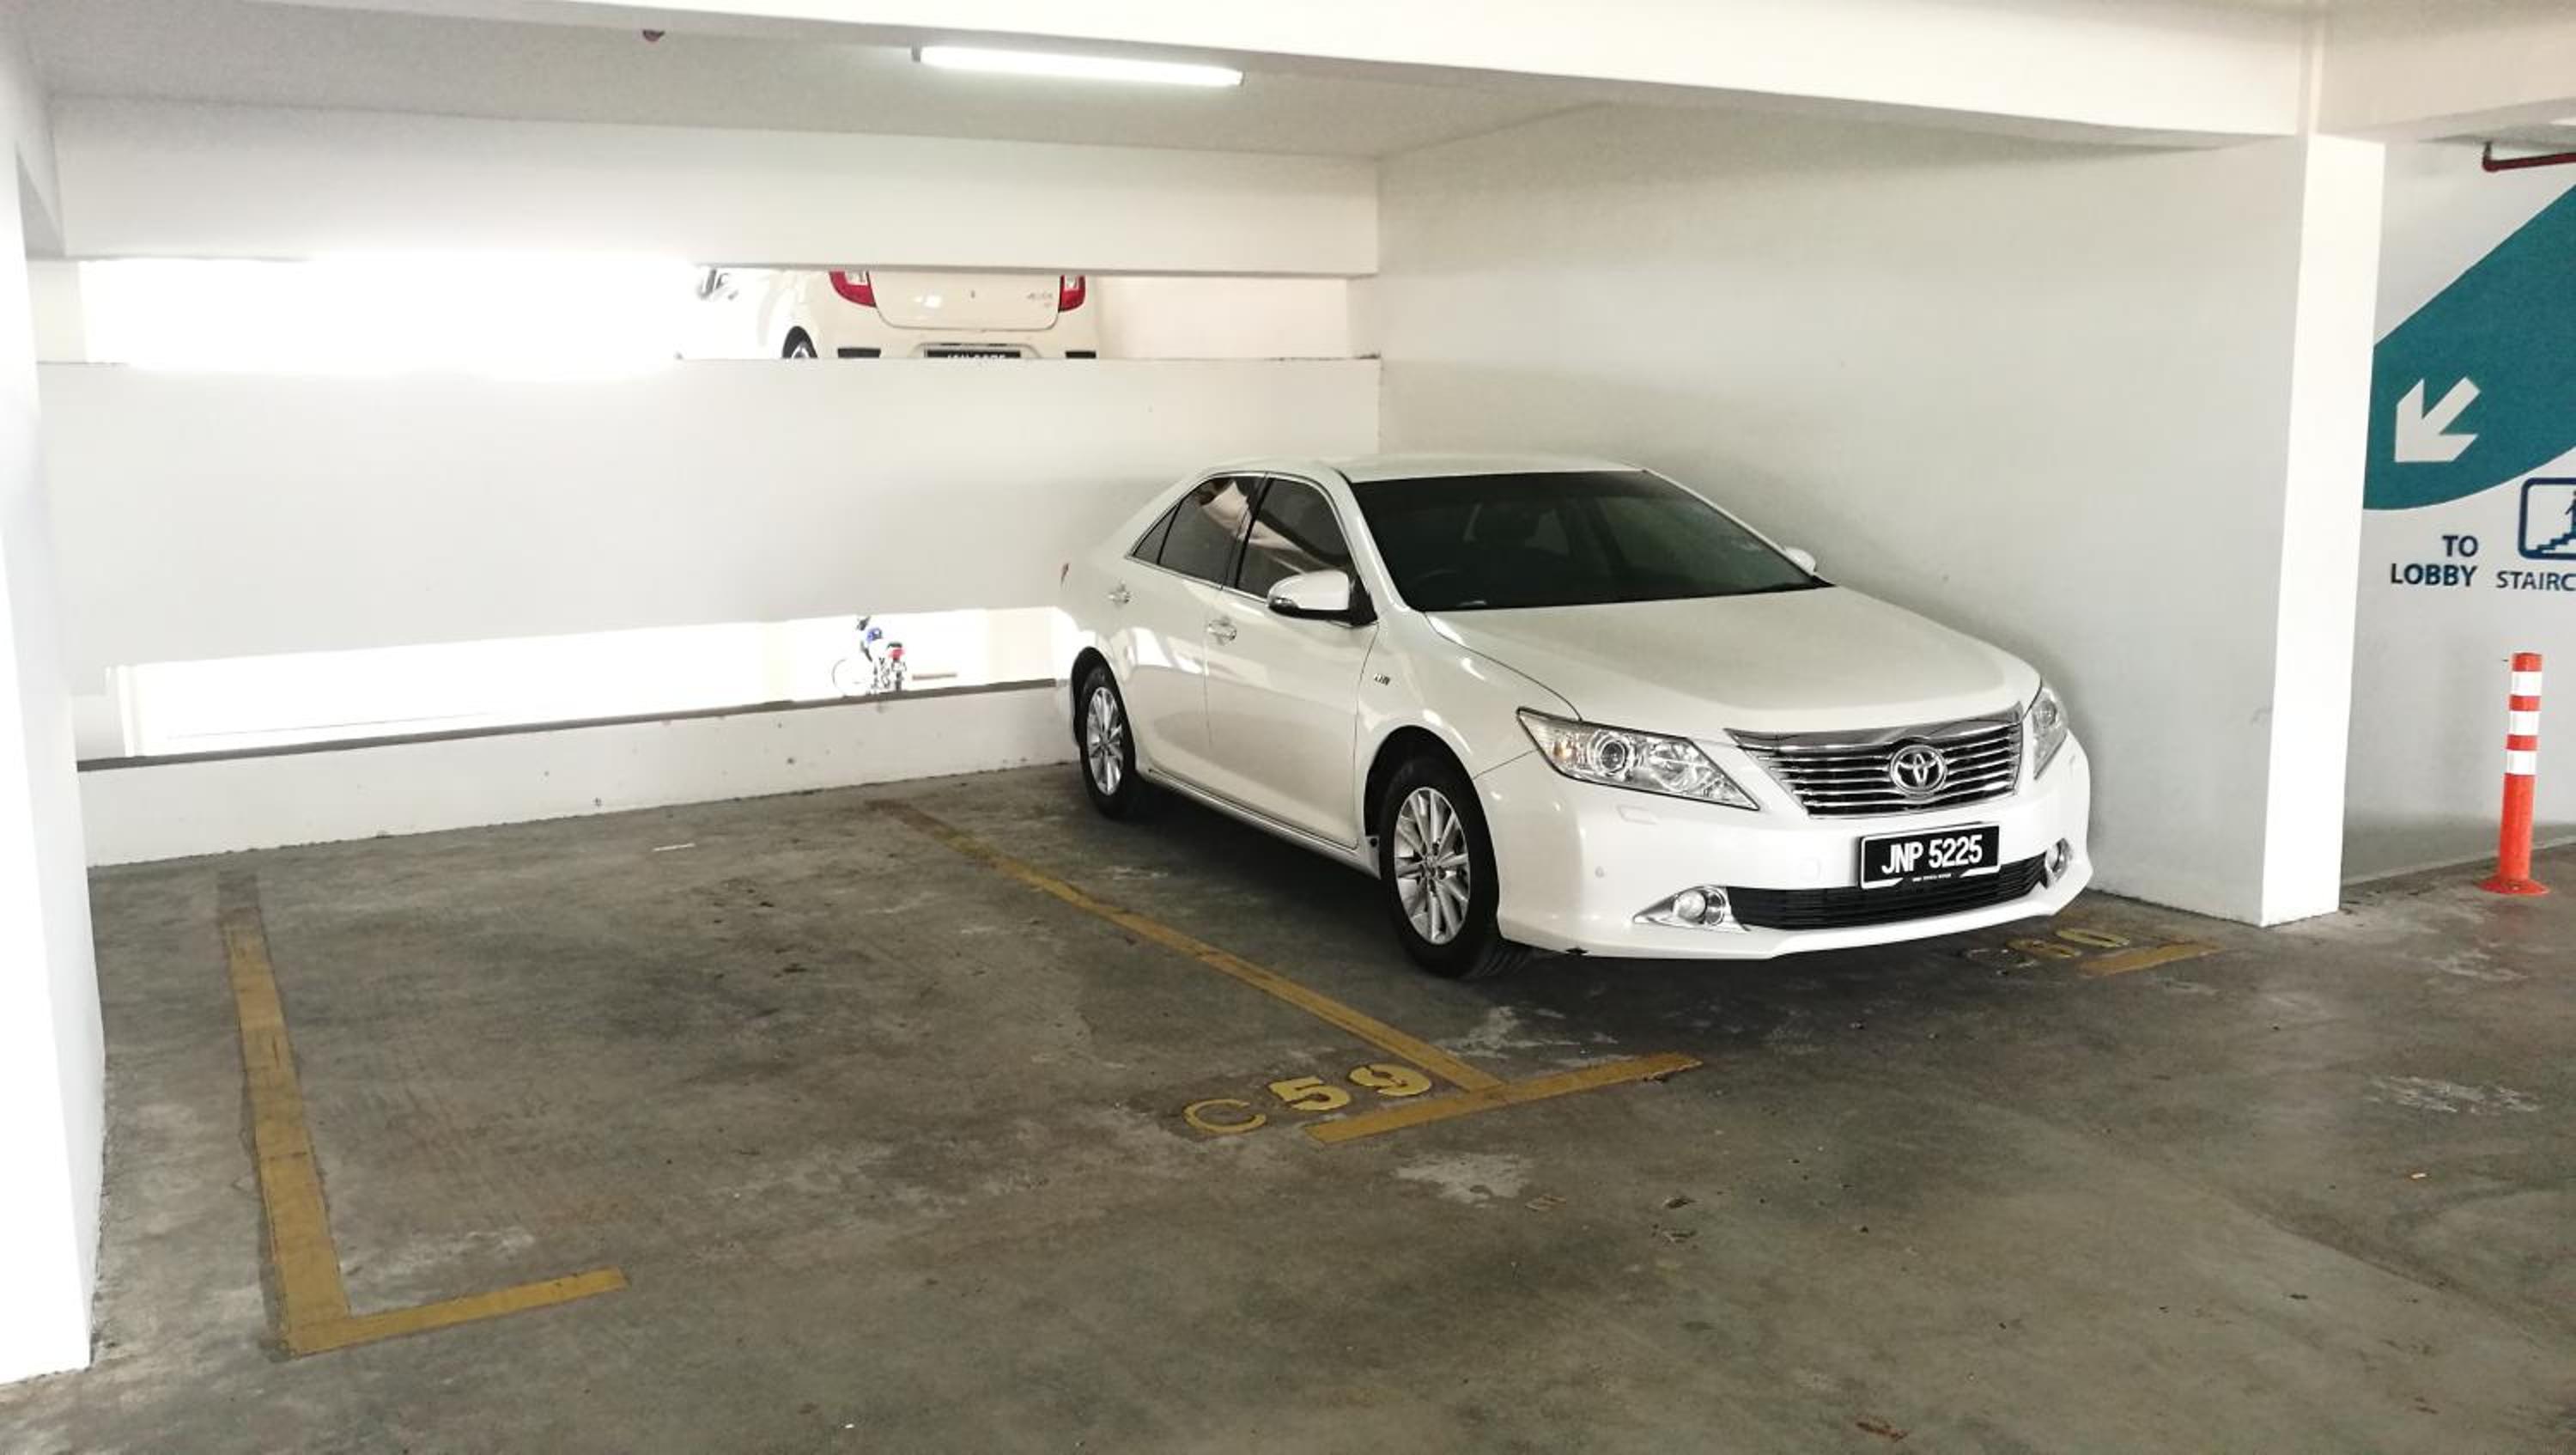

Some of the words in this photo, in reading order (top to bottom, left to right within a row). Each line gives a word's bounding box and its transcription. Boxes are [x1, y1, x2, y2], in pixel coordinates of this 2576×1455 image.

[2442, 534, 2479, 557] TO
[2391, 563, 2478, 587] LOBBY
[2495, 570, 2576, 591] STAIRC
[1881, 842, 1923, 874] JNP
[1929, 834, 1983, 868] 5225
